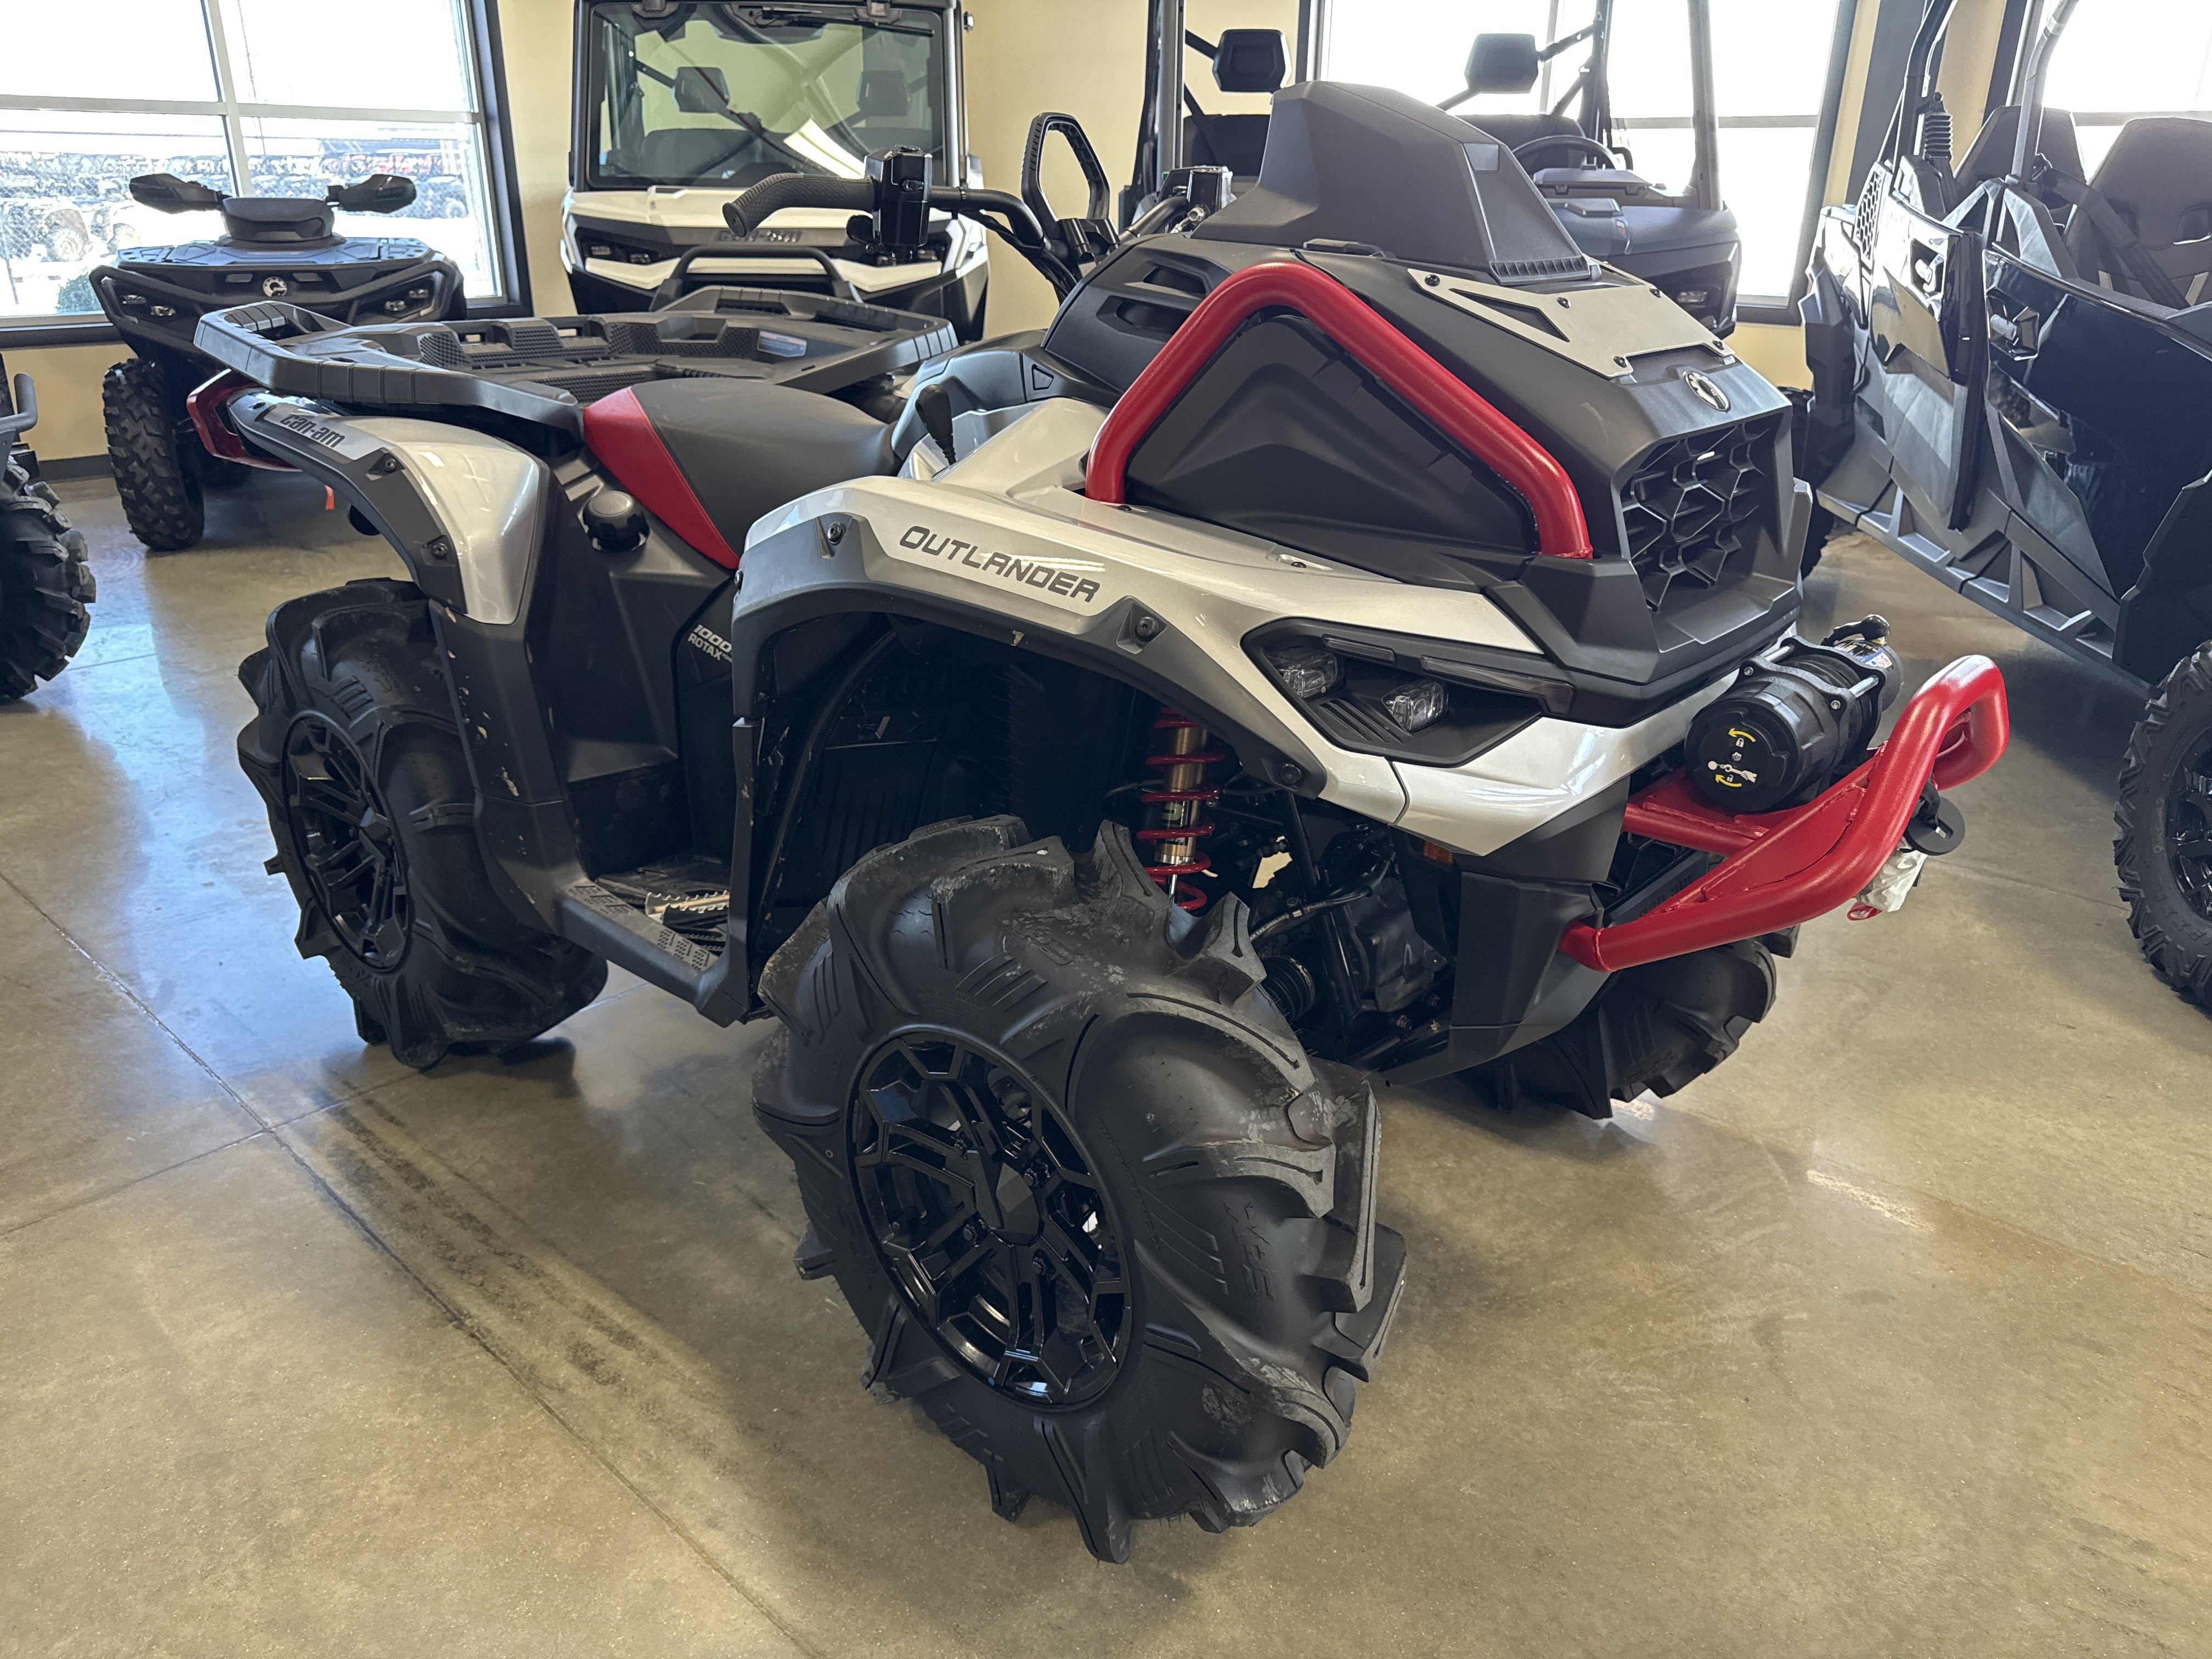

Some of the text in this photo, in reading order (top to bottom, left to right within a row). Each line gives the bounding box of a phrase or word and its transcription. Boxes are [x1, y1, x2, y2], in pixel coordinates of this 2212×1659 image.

[280, 414, 345, 448] can-am
[899, 525, 1101, 603] OUTLANDER
[687, 633, 722, 661] ROTAX
